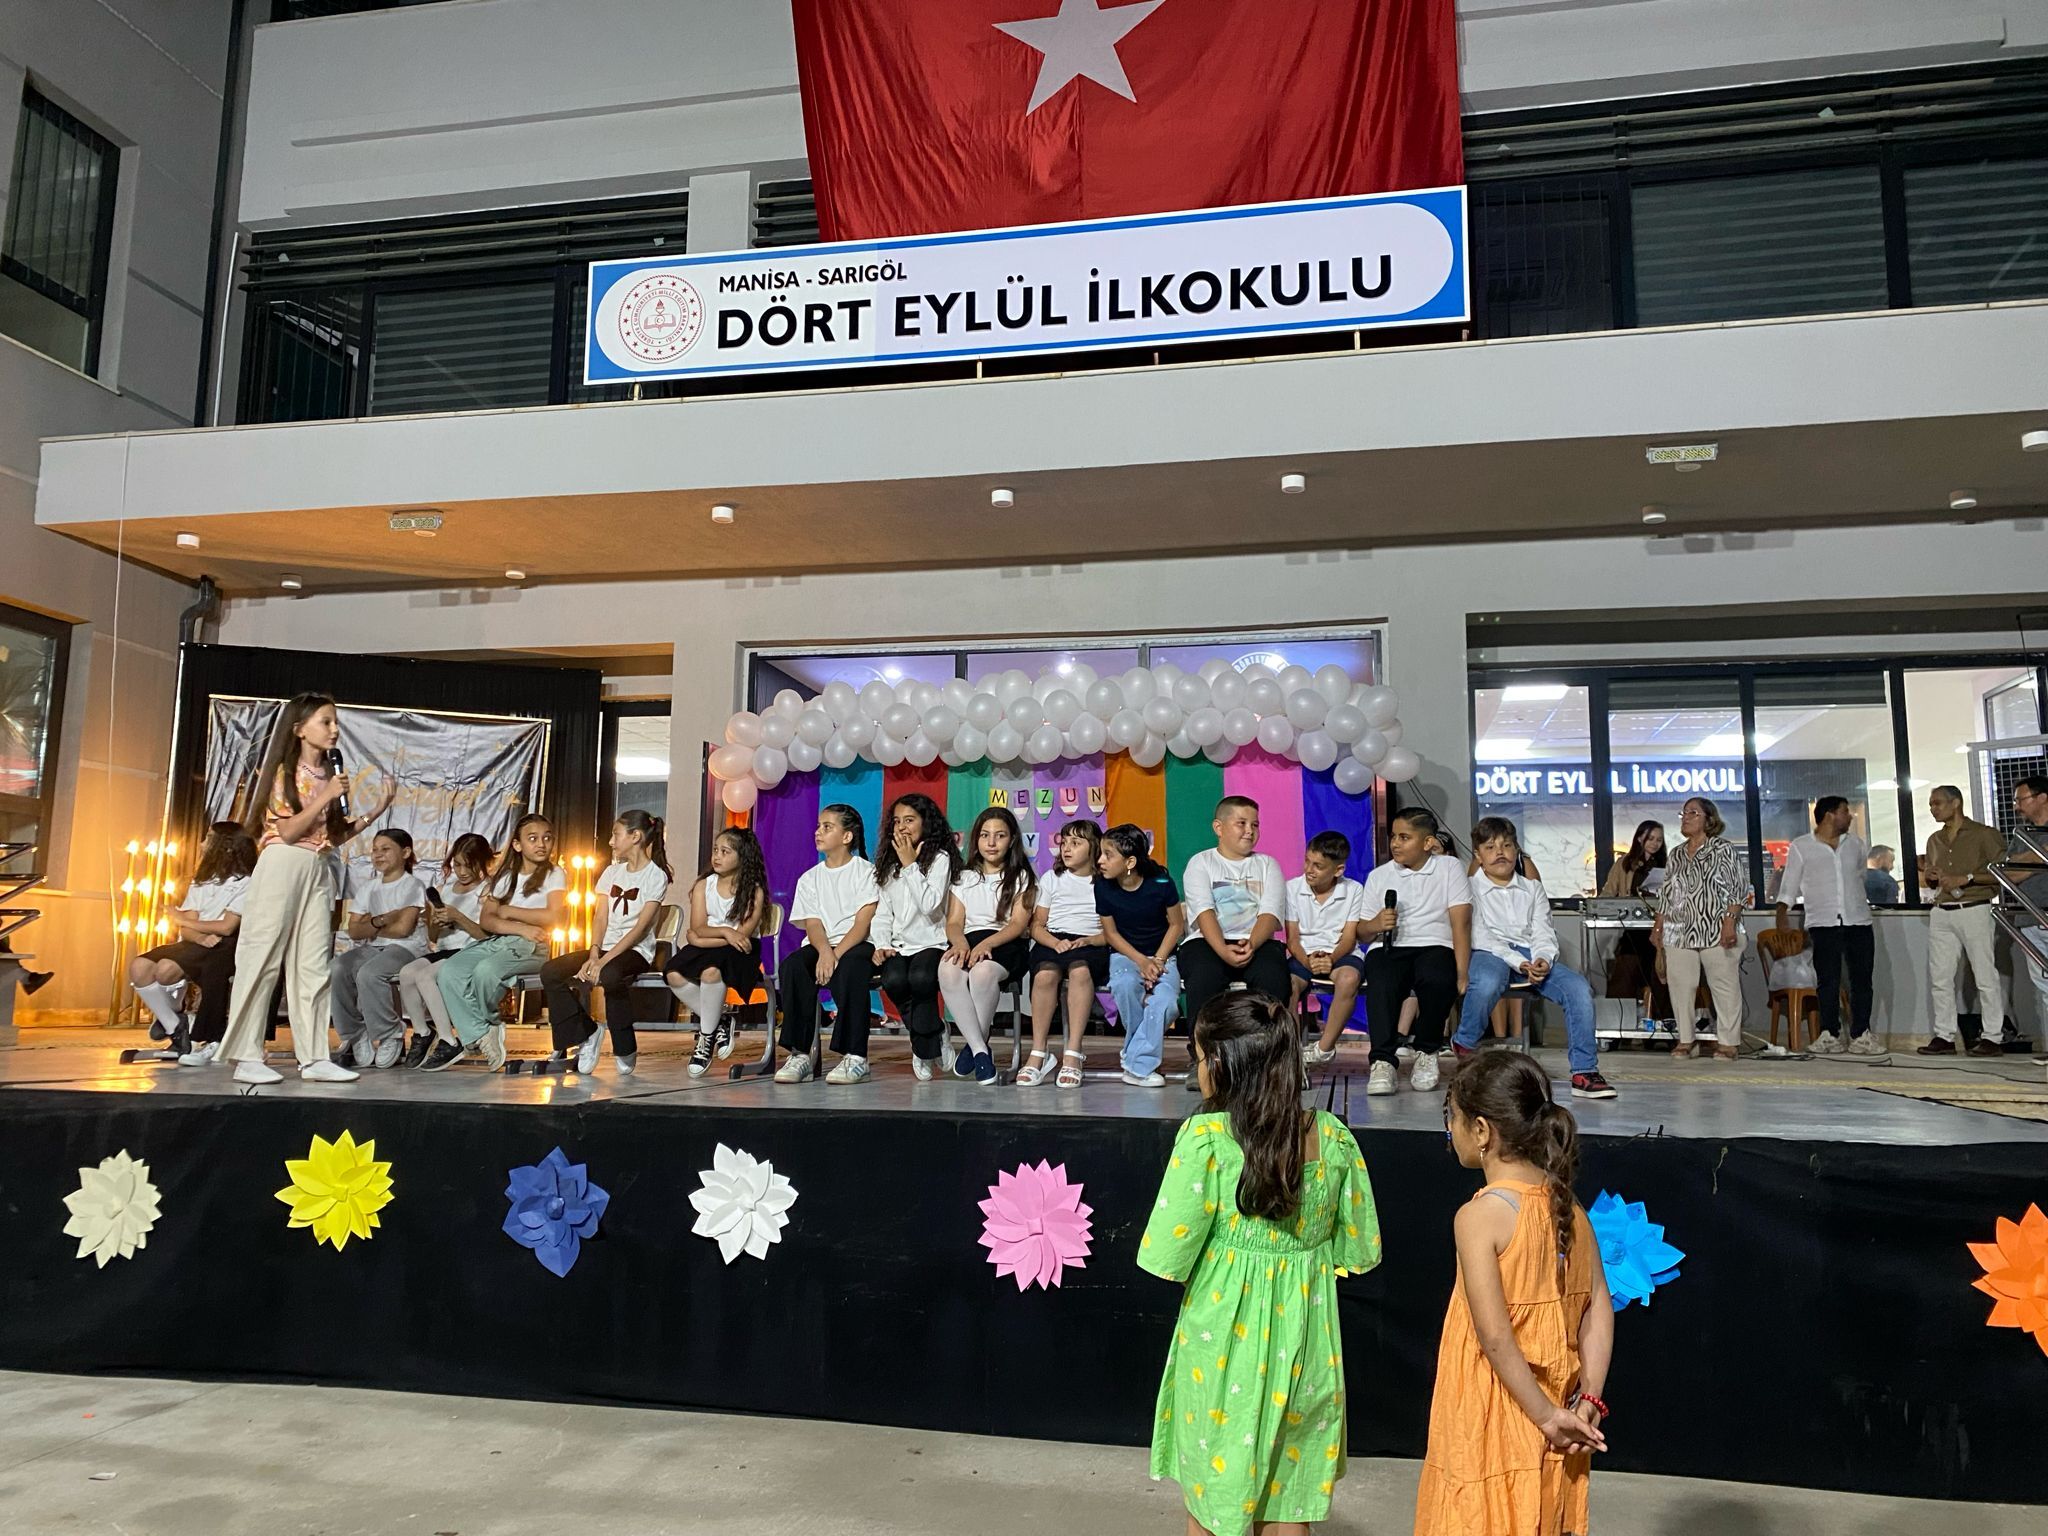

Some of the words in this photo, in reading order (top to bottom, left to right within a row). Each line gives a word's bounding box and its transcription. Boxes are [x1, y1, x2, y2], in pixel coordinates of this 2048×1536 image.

[719, 268, 800, 293] MANİSA
[817, 260, 908, 286] SARIGÖL
[718, 294, 872, 350] DÖRT
[894, 275, 1068, 338] EYLÜL
[1088, 254, 1392, 323] İLKOKULU
[991, 787, 1102, 805] MEZUN
[1475, 766, 1542, 795] DÖRT
[1547, 771, 1627, 794] EYLL
